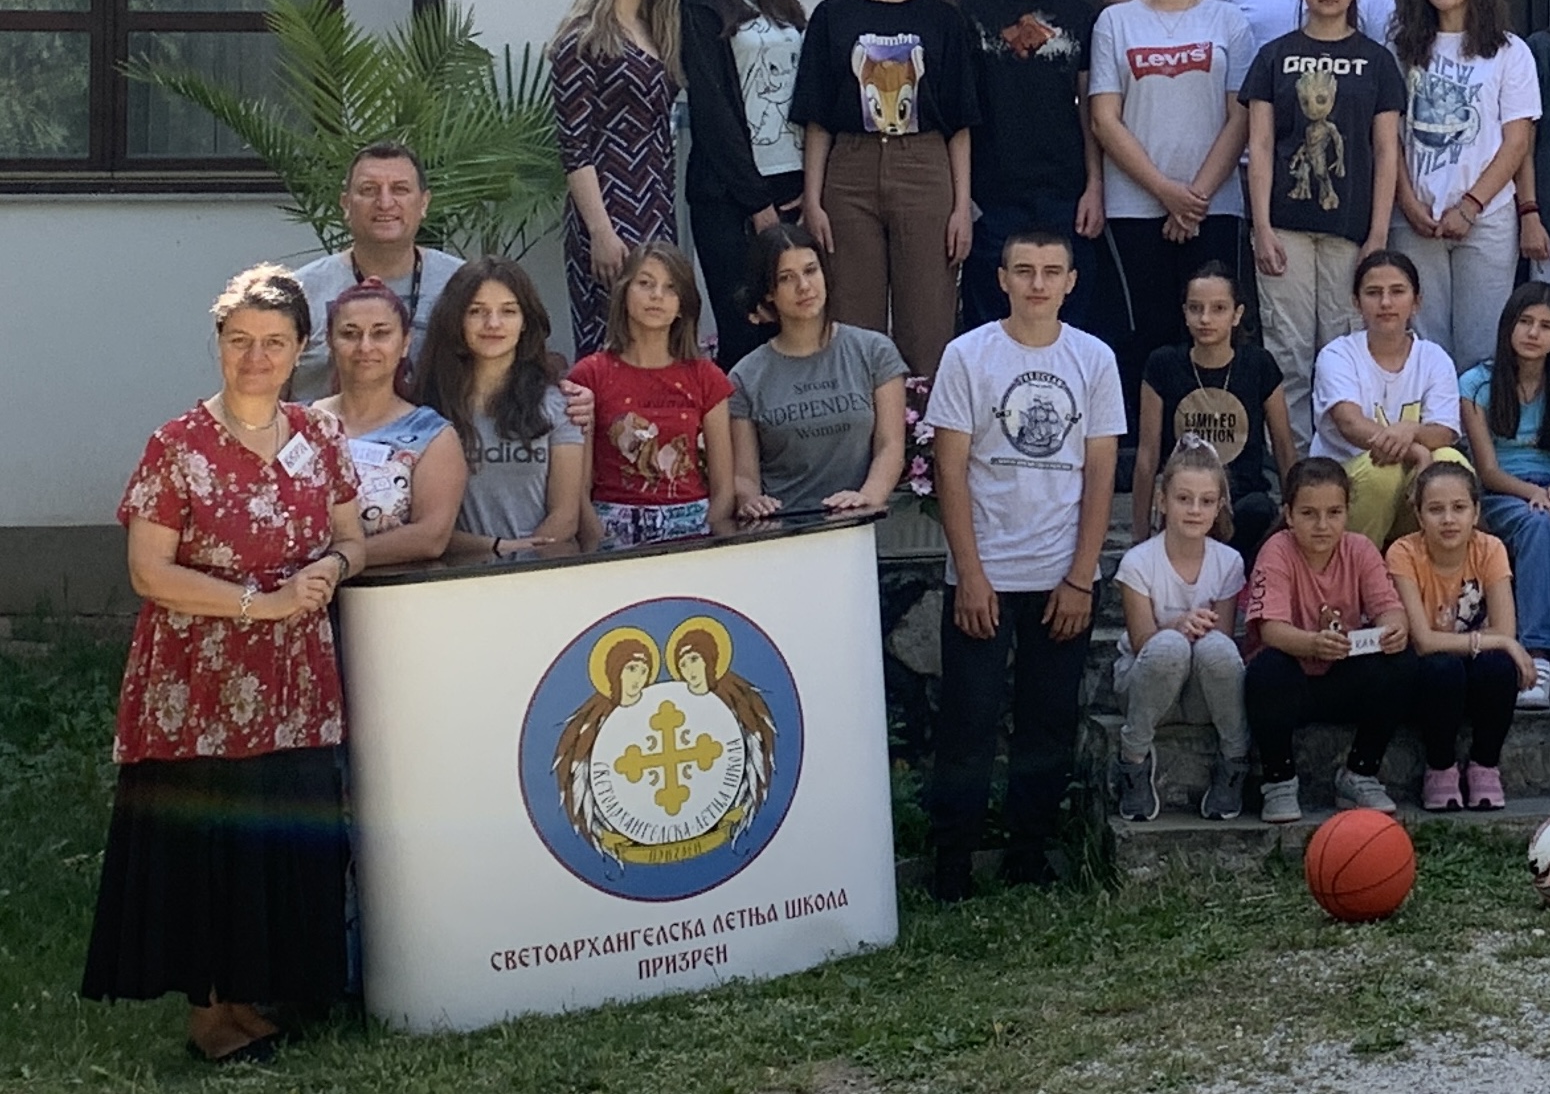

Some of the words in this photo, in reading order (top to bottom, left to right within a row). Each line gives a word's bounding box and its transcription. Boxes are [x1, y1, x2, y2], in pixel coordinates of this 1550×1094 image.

[793, 378, 838, 395] Strong
[1184, 412, 1237, 428] LIMITED
[794, 422, 851, 440] Woman
[1184, 428, 1235, 443] ITION
[490, 918, 706, 972] СВЕТОАРХАНГЕЛСКА
[713, 903, 779, 935] ЛЕТЊА
[785, 888, 850, 920] ШКОЛА
[638, 944, 728, 980] ПРИЗРЕН
